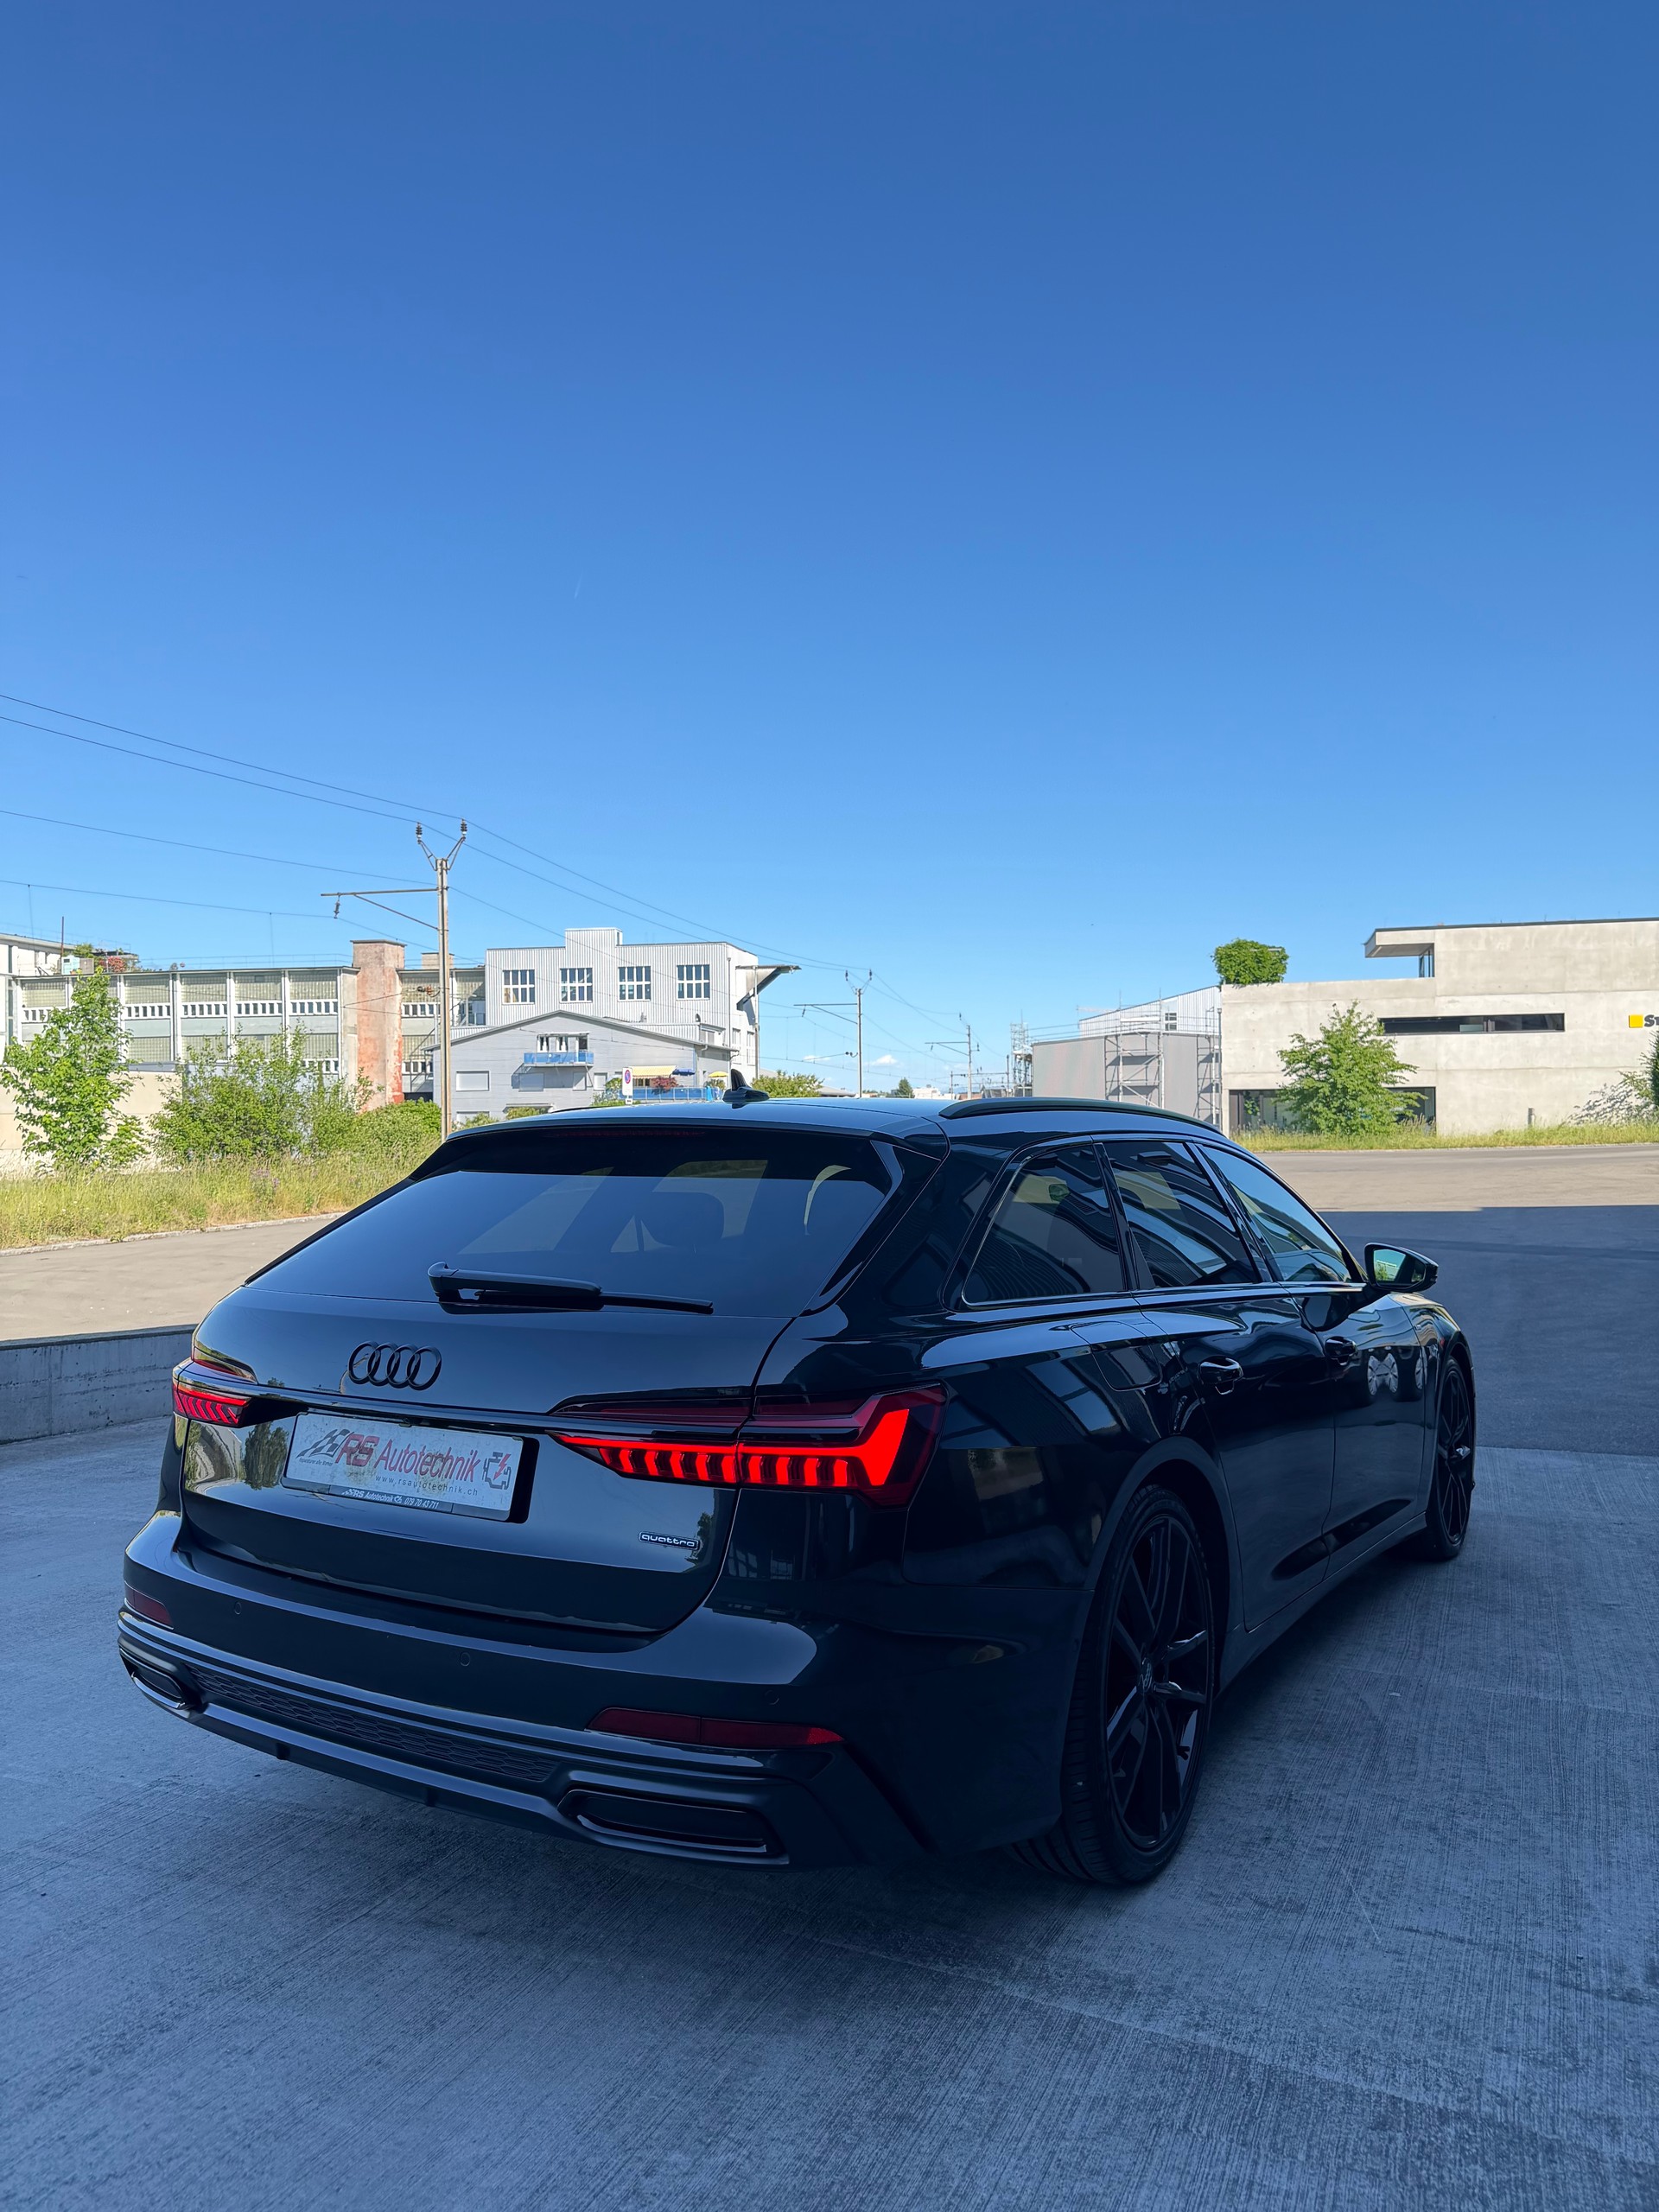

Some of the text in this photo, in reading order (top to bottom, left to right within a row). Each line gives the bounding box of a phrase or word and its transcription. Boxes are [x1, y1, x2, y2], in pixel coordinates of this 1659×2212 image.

[334, 1433, 481, 1483] RS Autotechnik
[375, 1475, 478, 1496] www.rsautotechnik.ch
[353, 1490, 365, 1498] RS
[364, 1491, 394, 1503] Autotechnik
[641, 1534, 695, 1547] quattro
